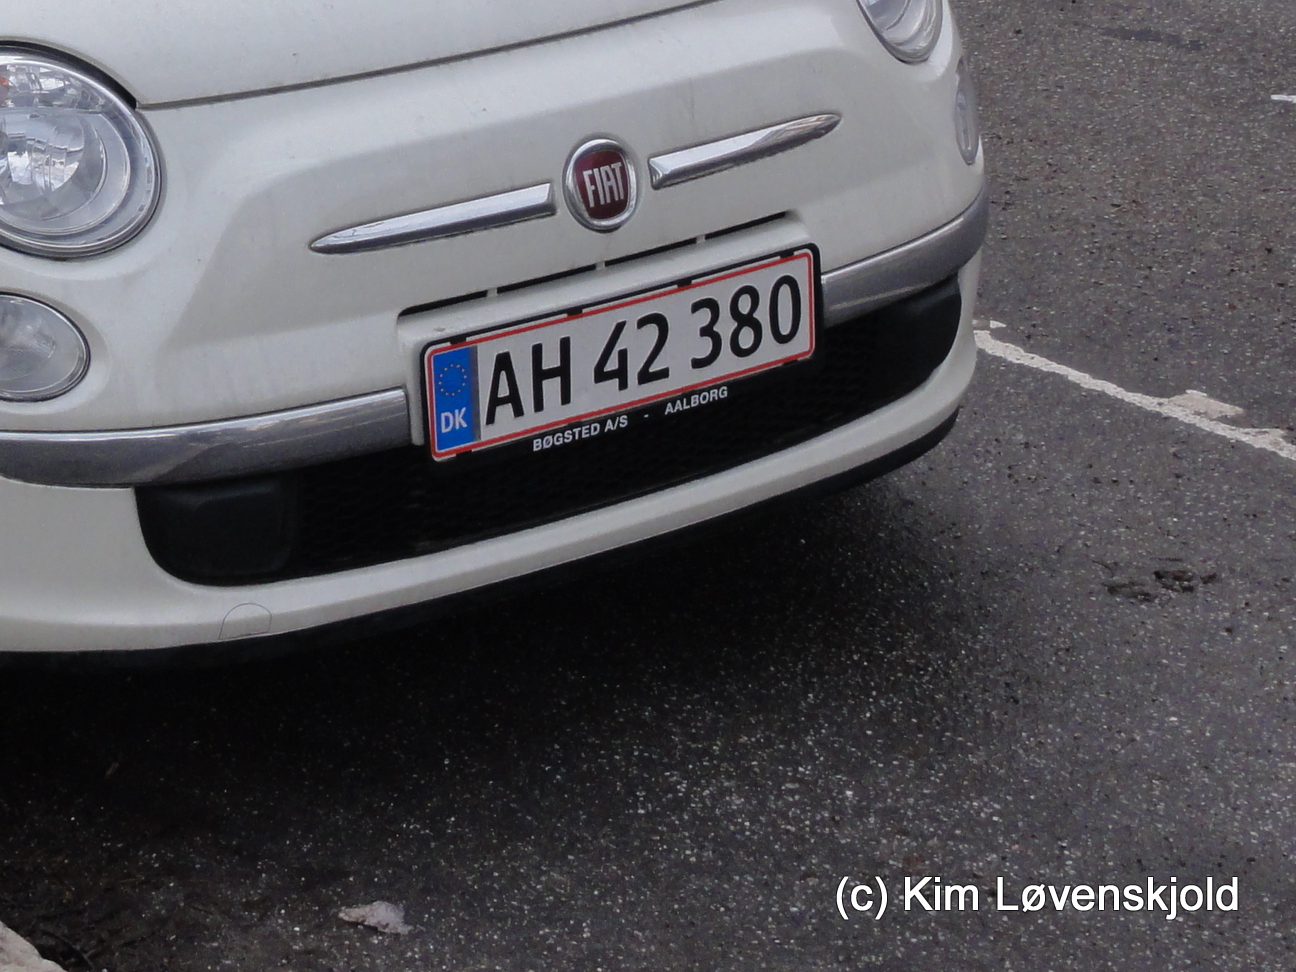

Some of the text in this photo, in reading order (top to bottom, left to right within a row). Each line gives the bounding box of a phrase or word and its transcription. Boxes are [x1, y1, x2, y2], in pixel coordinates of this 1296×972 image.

[582, 161, 624, 208] FIAT
[485, 274, 802, 426] AH 42 380
[440, 406, 468, 434] DK
[532, 422, 600, 452] BØGSTED
[604, 414, 628, 432] A/S
[664, 387, 728, 416] AALBORG
